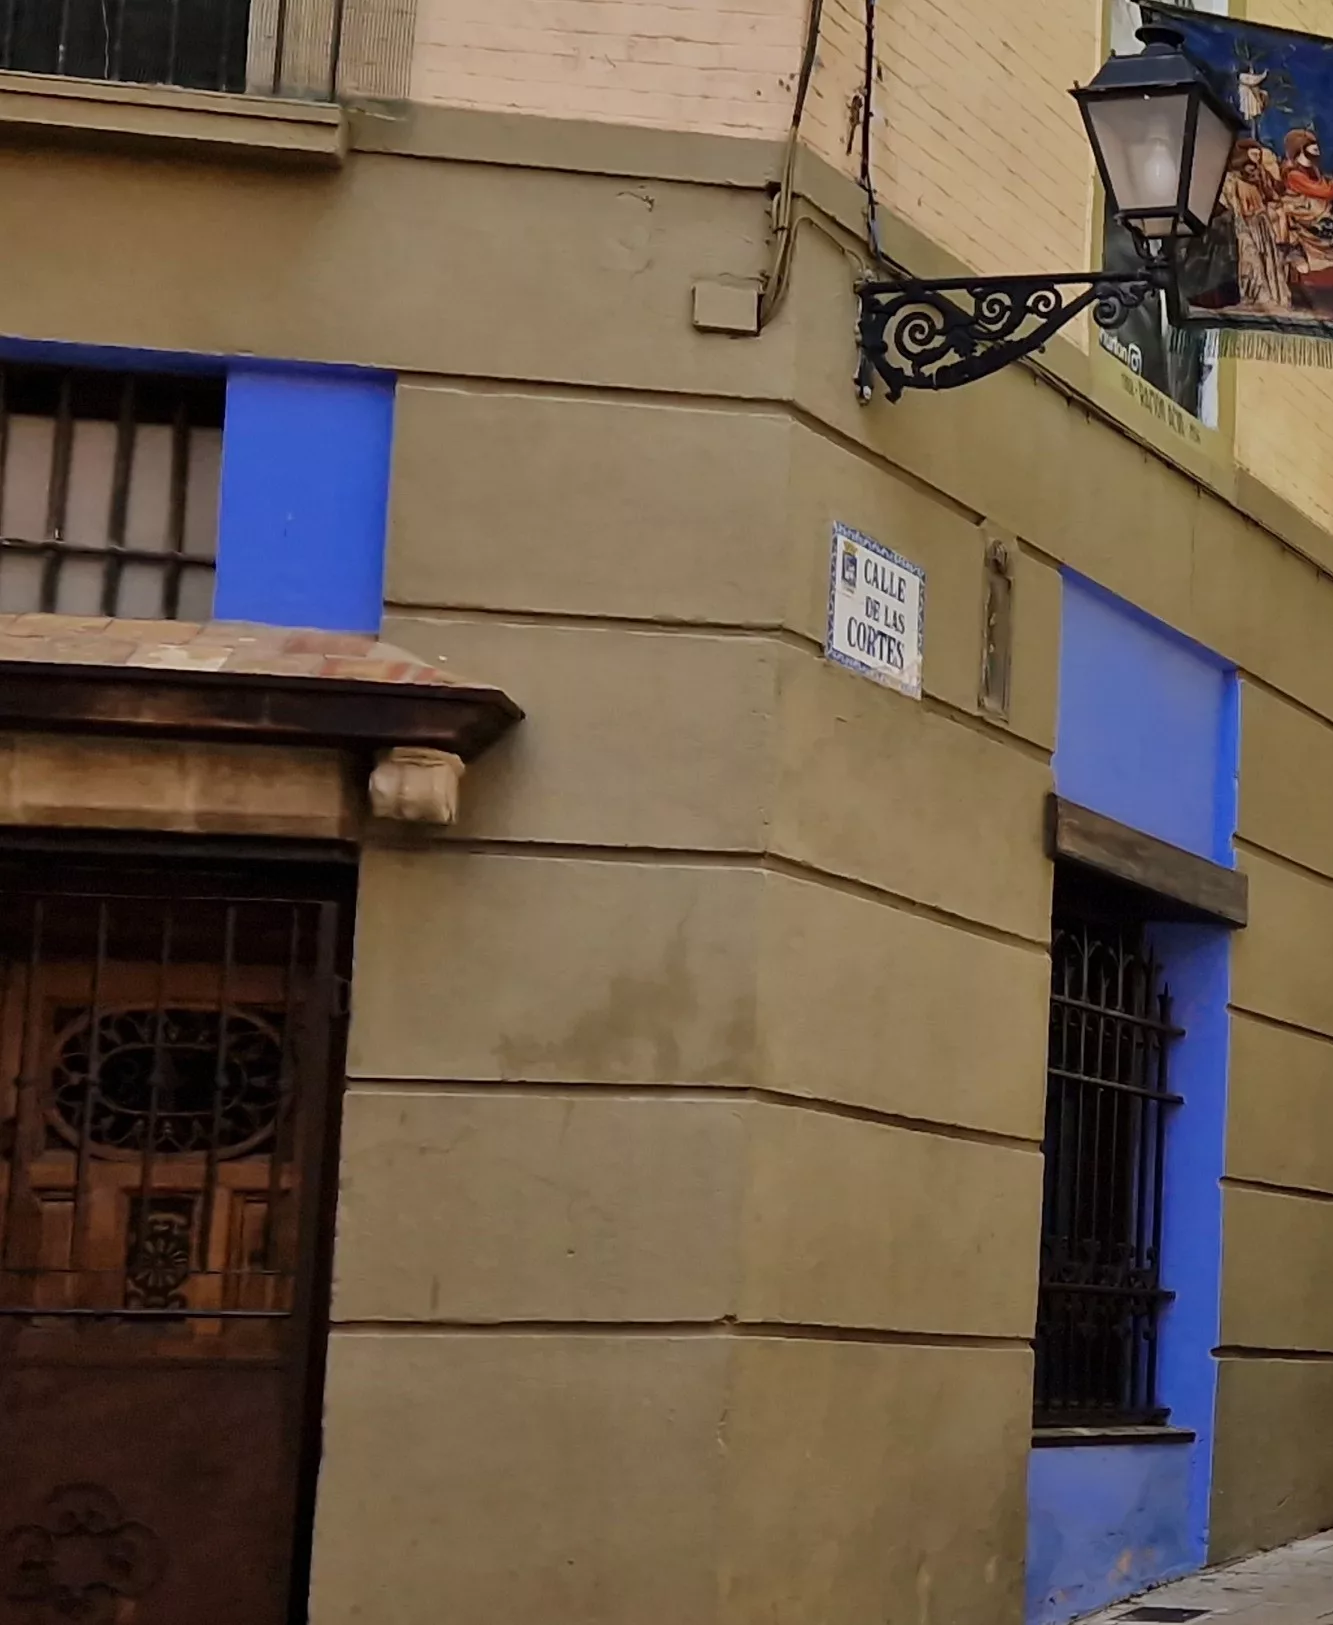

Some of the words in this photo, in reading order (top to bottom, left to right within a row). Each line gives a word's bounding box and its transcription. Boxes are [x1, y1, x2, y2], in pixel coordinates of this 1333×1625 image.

[864, 558, 907, 603] CALLE
[865, 596, 880, 623] DE
[884, 605, 905, 635] LAS
[847, 616, 904, 670] CORTES
